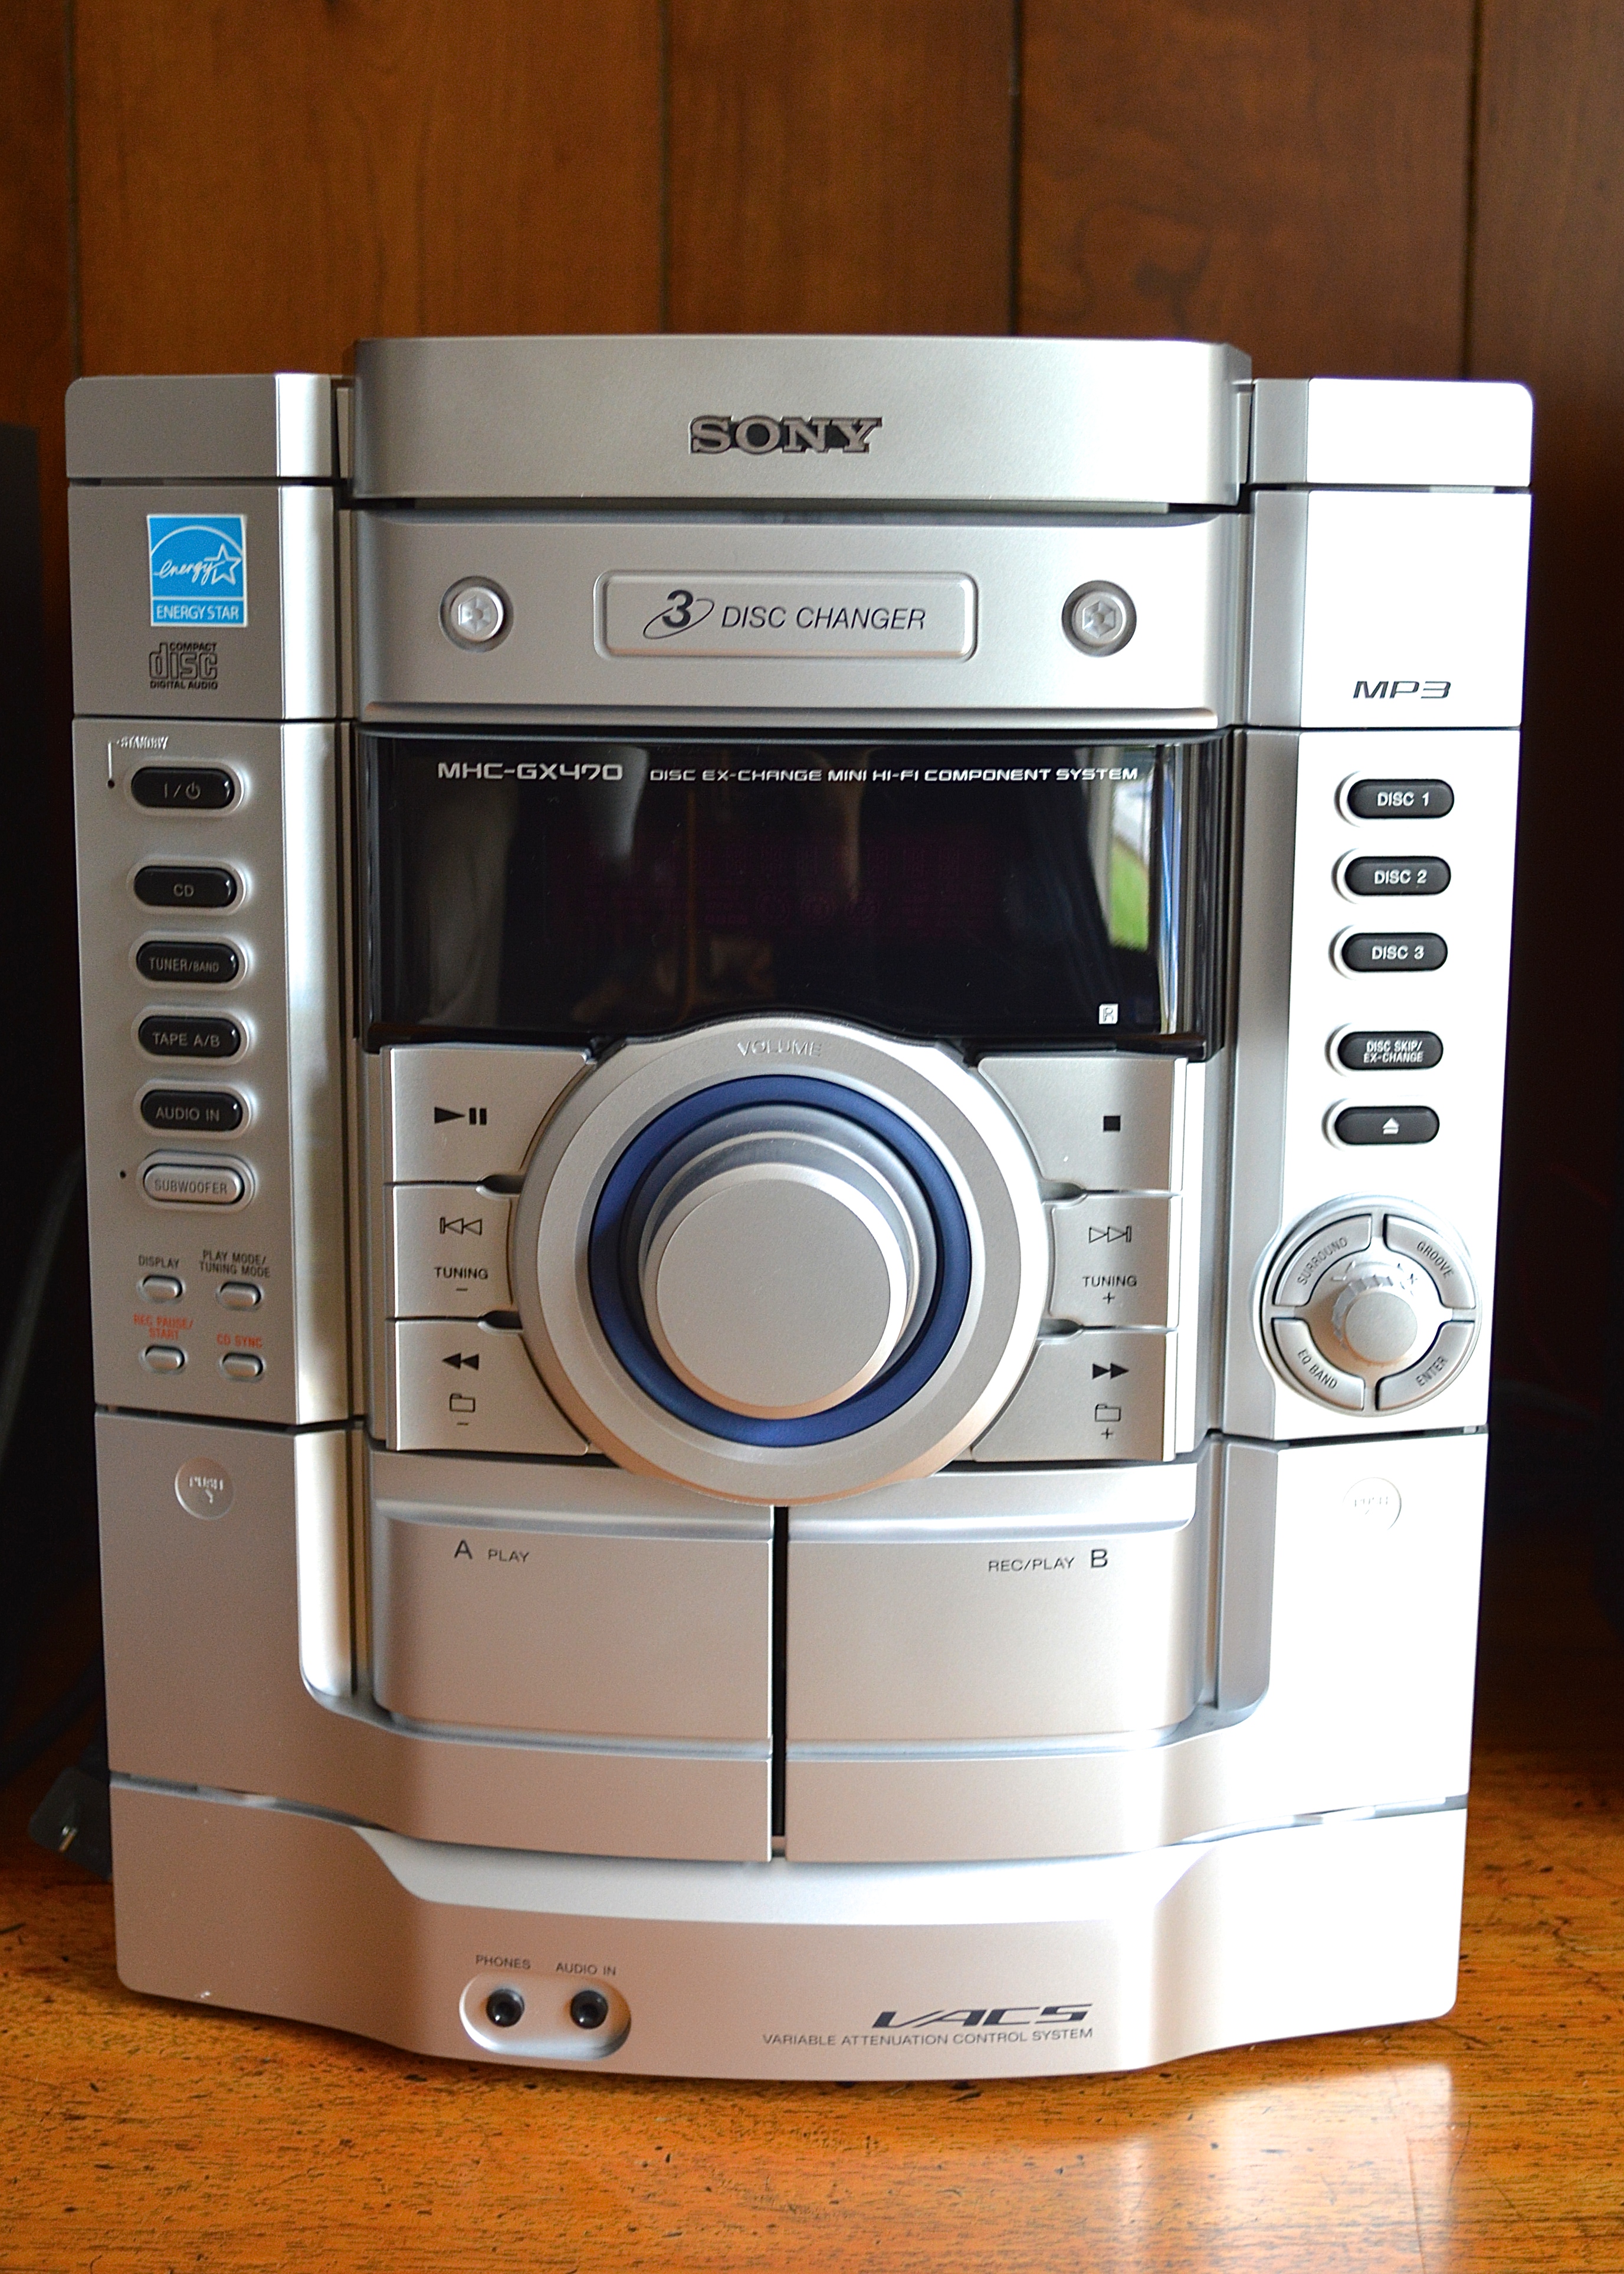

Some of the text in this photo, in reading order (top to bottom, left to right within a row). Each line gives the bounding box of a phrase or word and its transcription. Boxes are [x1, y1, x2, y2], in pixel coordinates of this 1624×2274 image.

[690, 415, 883, 455] SONY
[156, 603, 240, 621] ENERGY STAR
[662, 590, 927, 631] 3 DISC CHANGER
[169, 642, 218, 651] COMPACT
[149, 680, 218, 690] DIGITAL AUDIO
[1353, 680, 1452, 700] MP3
[120, 736, 169, 750] STANDBY
[437, 763, 1139, 782] MHC-GX470 DISC EX-CHANGE MINI HI-FI COMPONENT SYSTEM
[1377, 792, 1429, 806] DISC 1
[1374, 869, 1428, 884] DISC 2
[173, 885, 194, 898] CD
[1372, 945, 1425, 960] DISC 3
[149, 957, 220, 973] TUNER/BAND
[152, 1032, 220, 1048] TAPE A/B
[737, 1039, 822, 1056] VOLUME
[1366, 1040, 1423, 1052] DISC SKIP/
[1363, 1052, 1424, 1064] EX-CHANGE
[156, 1107, 220, 1121] AUDIO IN
[153, 1179, 228, 1195] SUBWOOFER
[138, 1255, 179, 1268] DISPLAY
[202, 1249, 267, 1265] PLAY MODE/
[1297, 1236, 1348, 1286] SURROUND
[1416, 1241, 1455, 1279] GROOVE
[199, 1261, 271, 1278] TUNING MODE
[434, 1266, 488, 1279] TUNING
[1082, 1275, 1137, 1287] TUNING
[133, 1313, 153, 1326] REC
[148, 1327, 180, 1340] START
[216, 1333, 263, 1348] CD SYNC
[1297, 1348, 1338, 1390] EQ BAND
[1415, 1356, 1447, 1388] ENTER
[454, 1540, 530, 1563] A PLAY
[988, 1548, 1108, 1572] REC/PLAY B
[475, 1954, 532, 1970] PHONES
[555, 1962, 616, 1976] AUDIO IN
[871, 2004, 1093, 2028] VACS
[762, 2028, 1094, 2046] VARIABLE ATTENUATION CONTROL SYSTEM
